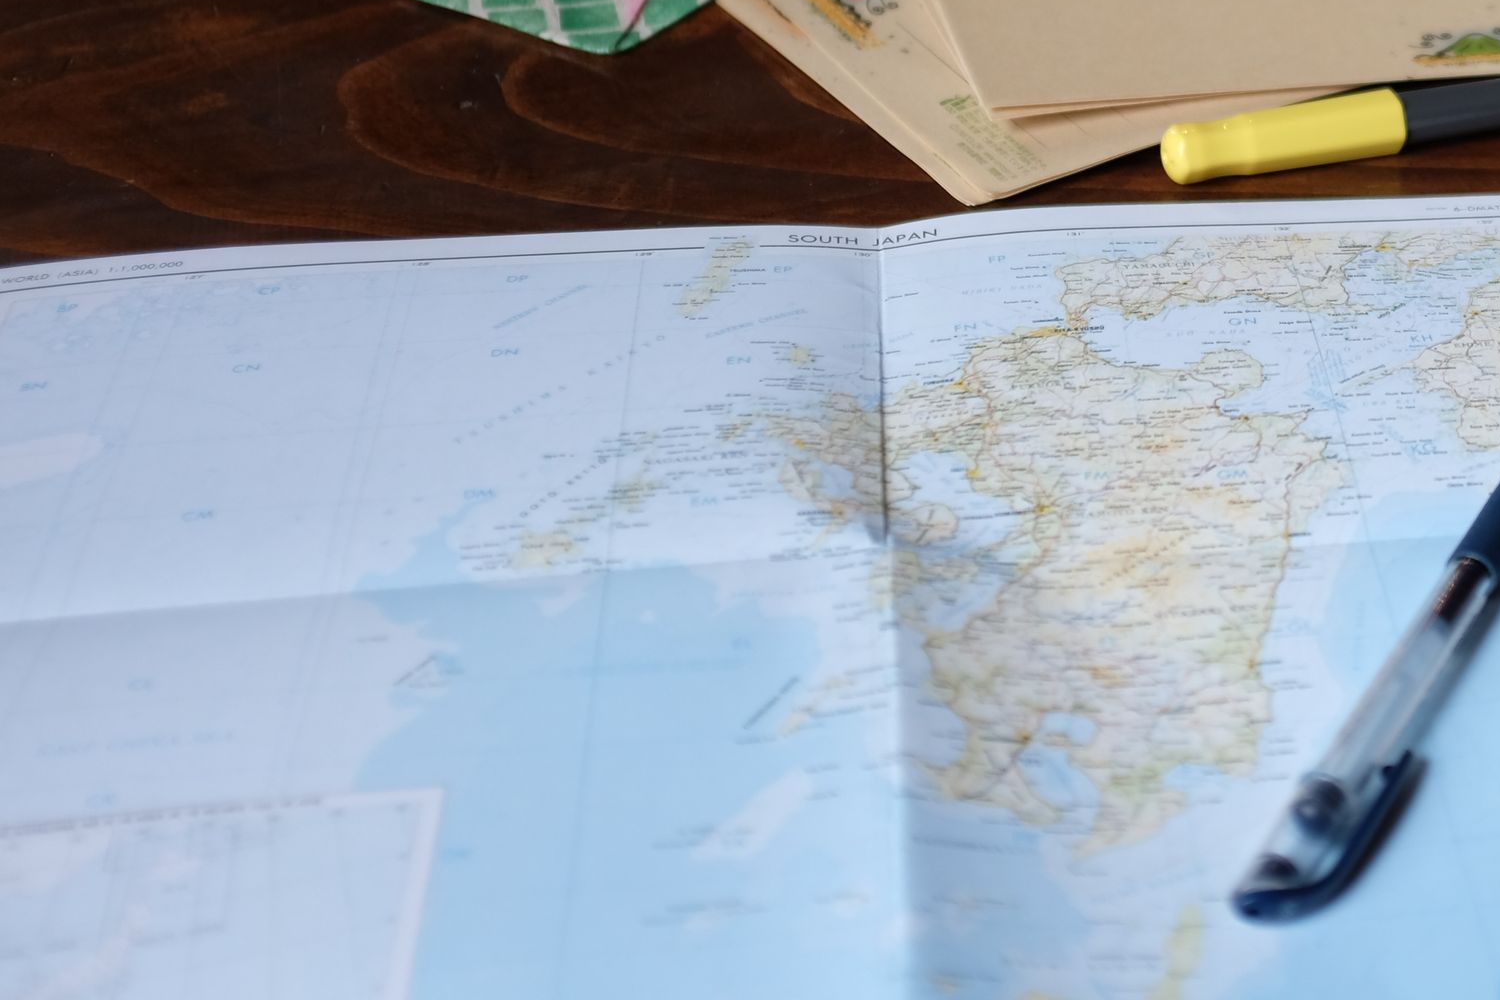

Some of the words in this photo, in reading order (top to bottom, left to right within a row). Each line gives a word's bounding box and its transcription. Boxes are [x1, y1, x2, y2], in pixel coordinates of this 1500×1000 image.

[786, 233, 859, 246] SOUTH
[871, 229, 938, 248] JAPAN
[773, 265, 793, 274] EP
[1, 273, 50, 285] WORLD
[57, 268, 100, 280] (ASIA)
[725, 354, 752, 365] EN
[232, 362, 260, 375] CN
